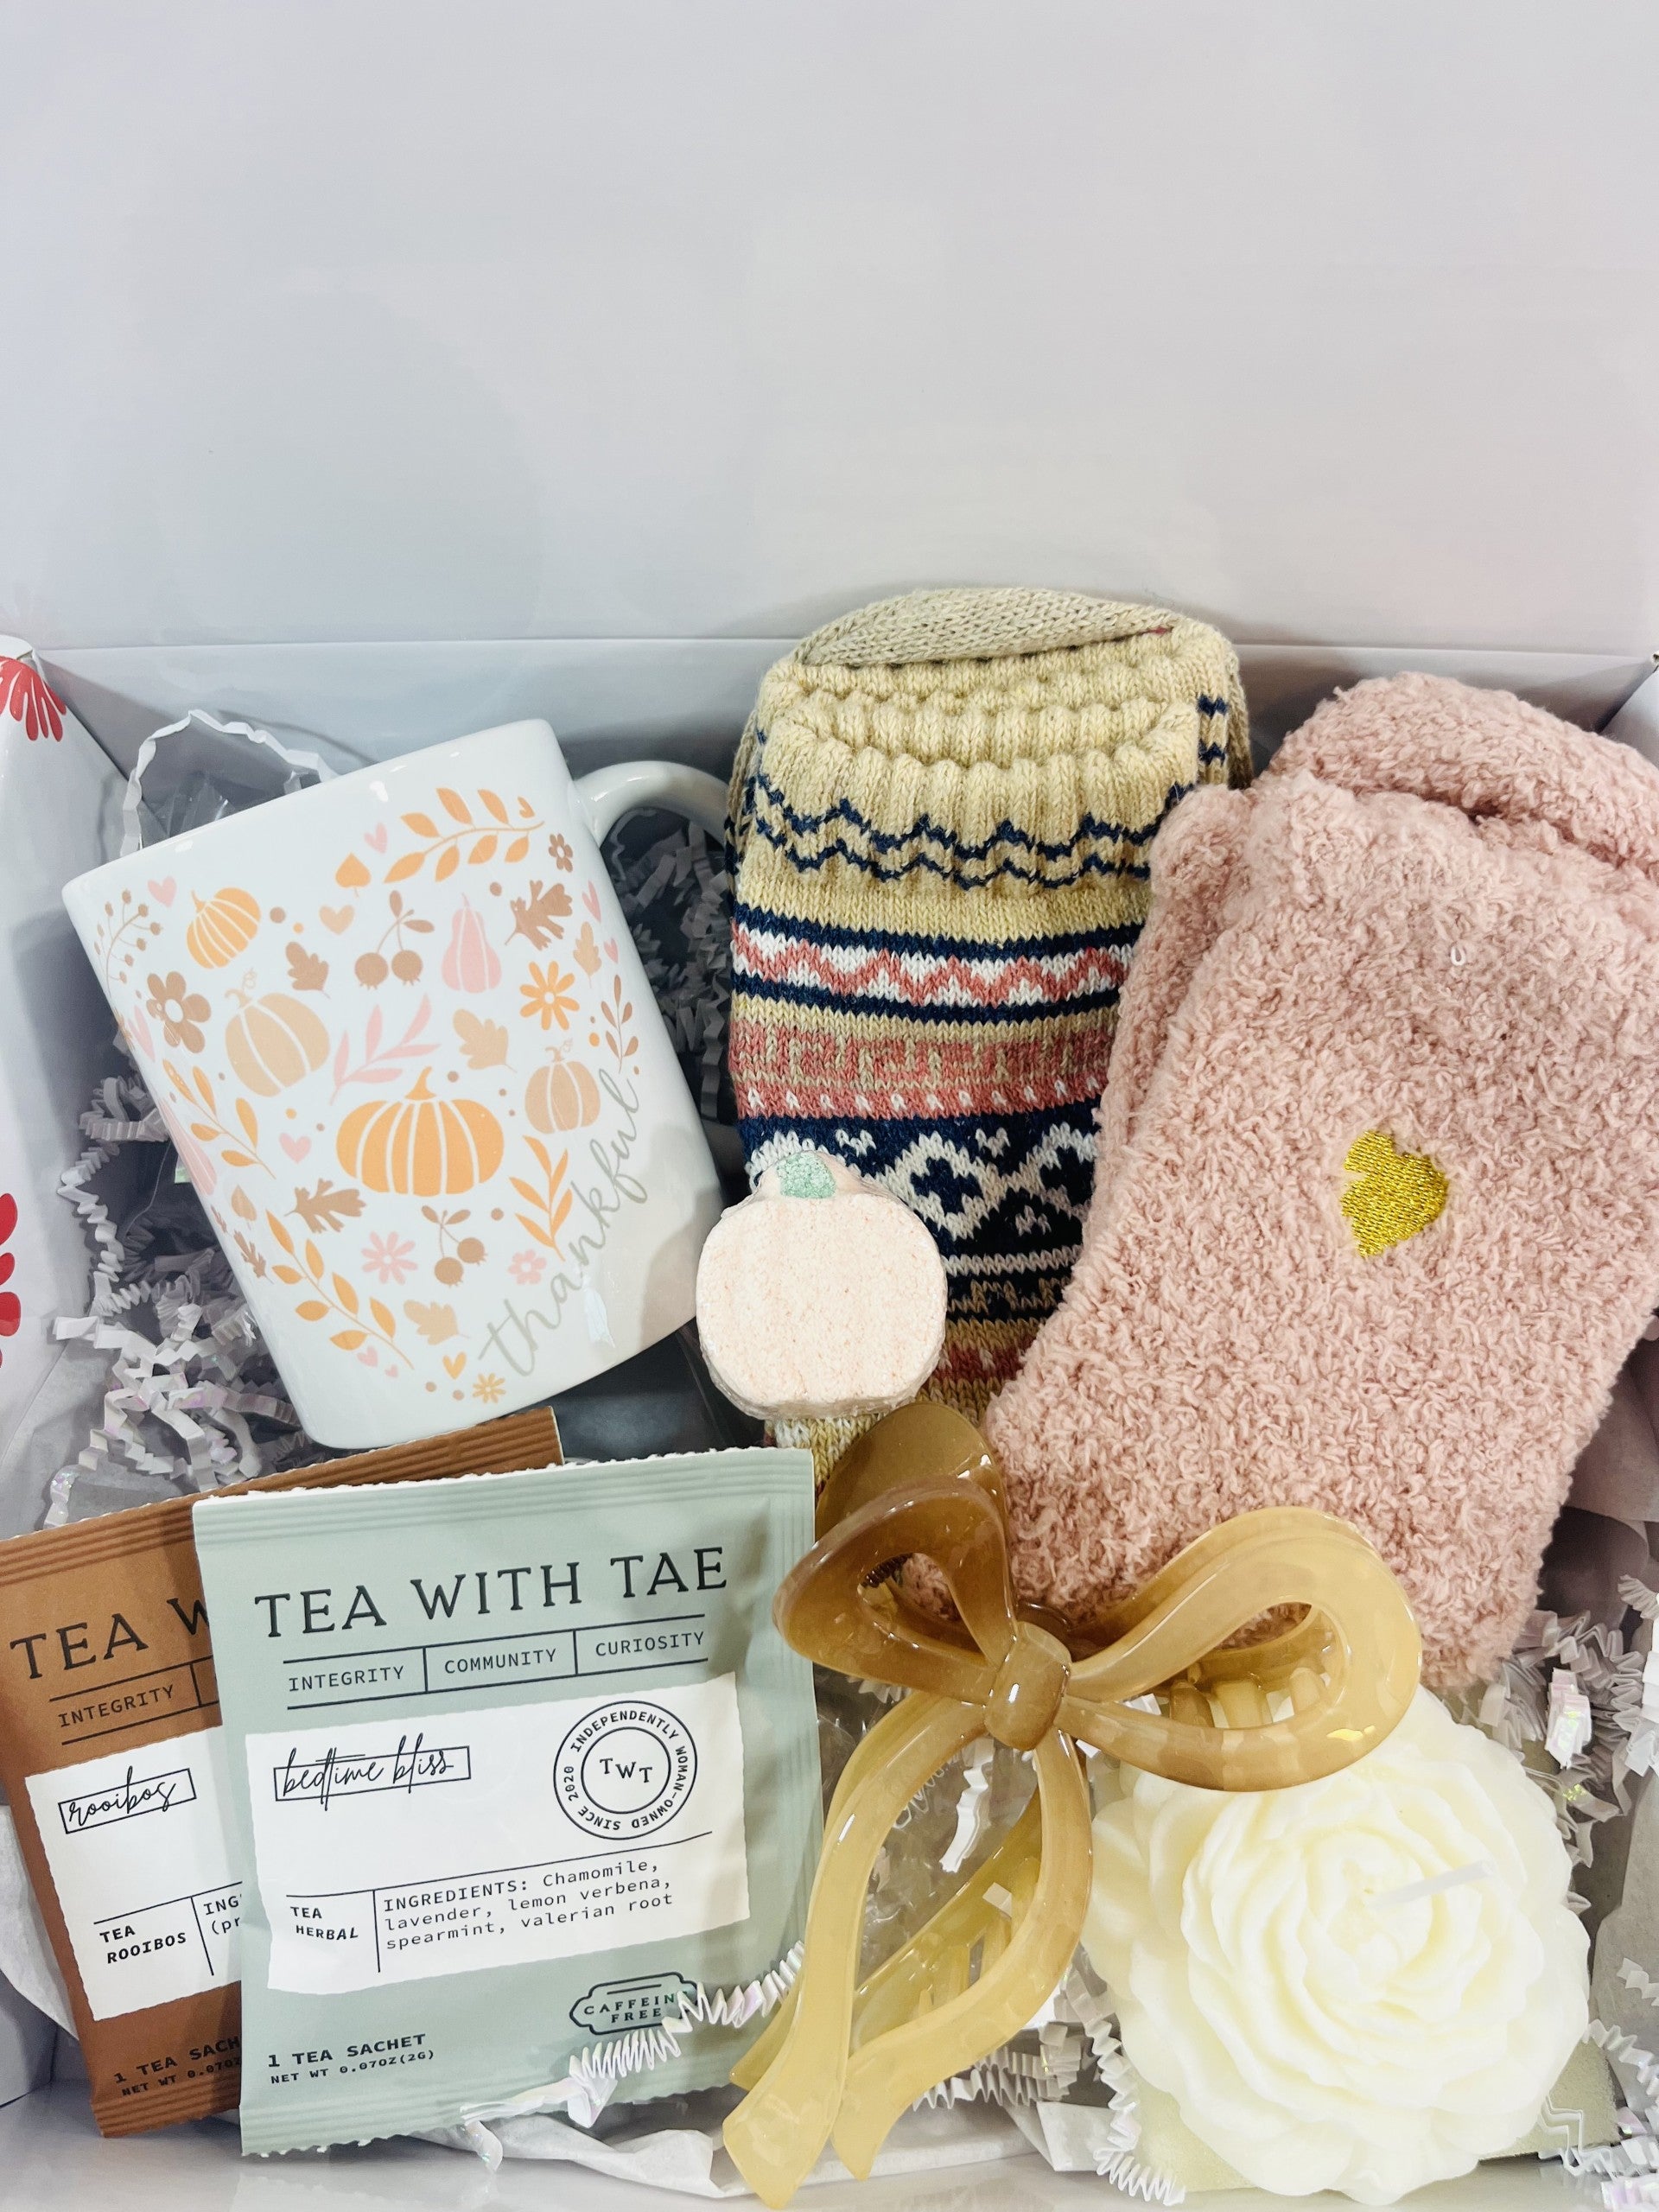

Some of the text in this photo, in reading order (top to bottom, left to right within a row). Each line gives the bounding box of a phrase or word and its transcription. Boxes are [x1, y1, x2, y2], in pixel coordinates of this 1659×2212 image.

[478, 1068, 648, 1377] thankful
[254, 1547, 728, 1637] TEA WITH TAE
[10, 1613, 149, 1680] TEA
[288, 1630, 705, 1692] INTEGRITY COMMUNITY CURIOSITY
[58, 1684, 175, 1728] INTEGRITY
[283, 1732, 454, 1812] bedtime bliss
[563, 1710, 689, 1831] INDEPENDENTLY WOMAN-OWNED SINCE 2020
[599, 1757, 653, 1783] TWT
[67, 1765, 177, 1827] rooibos
[203, 1893, 242, 1916] ING
[383, 1859, 658, 1912] INGREDIENTS: Chamomile,
[385, 1878, 671, 1931] lavender, lemon verbena,
[99, 1925, 136, 1944] TEA
[290, 1906, 322, 1920] TEA
[296, 1924, 359, 1941] HERBAL
[386, 1892, 673, 1950] spearmint, valerian root
[106, 1932, 188, 1965] ROOIBOS
[583, 1991, 688, 2015] CAFFEIN
[611, 2007, 662, 2024] FREE
[114, 2036, 241, 2084] 1 TEA SACH
[268, 2033, 426, 2068] 1 TEA SACHET
[122, 2082, 149, 2096] NET
[158, 2075, 177, 2087] WT
[270, 2072, 300, 2084] NET
[309, 2068, 329, 2078] WT
